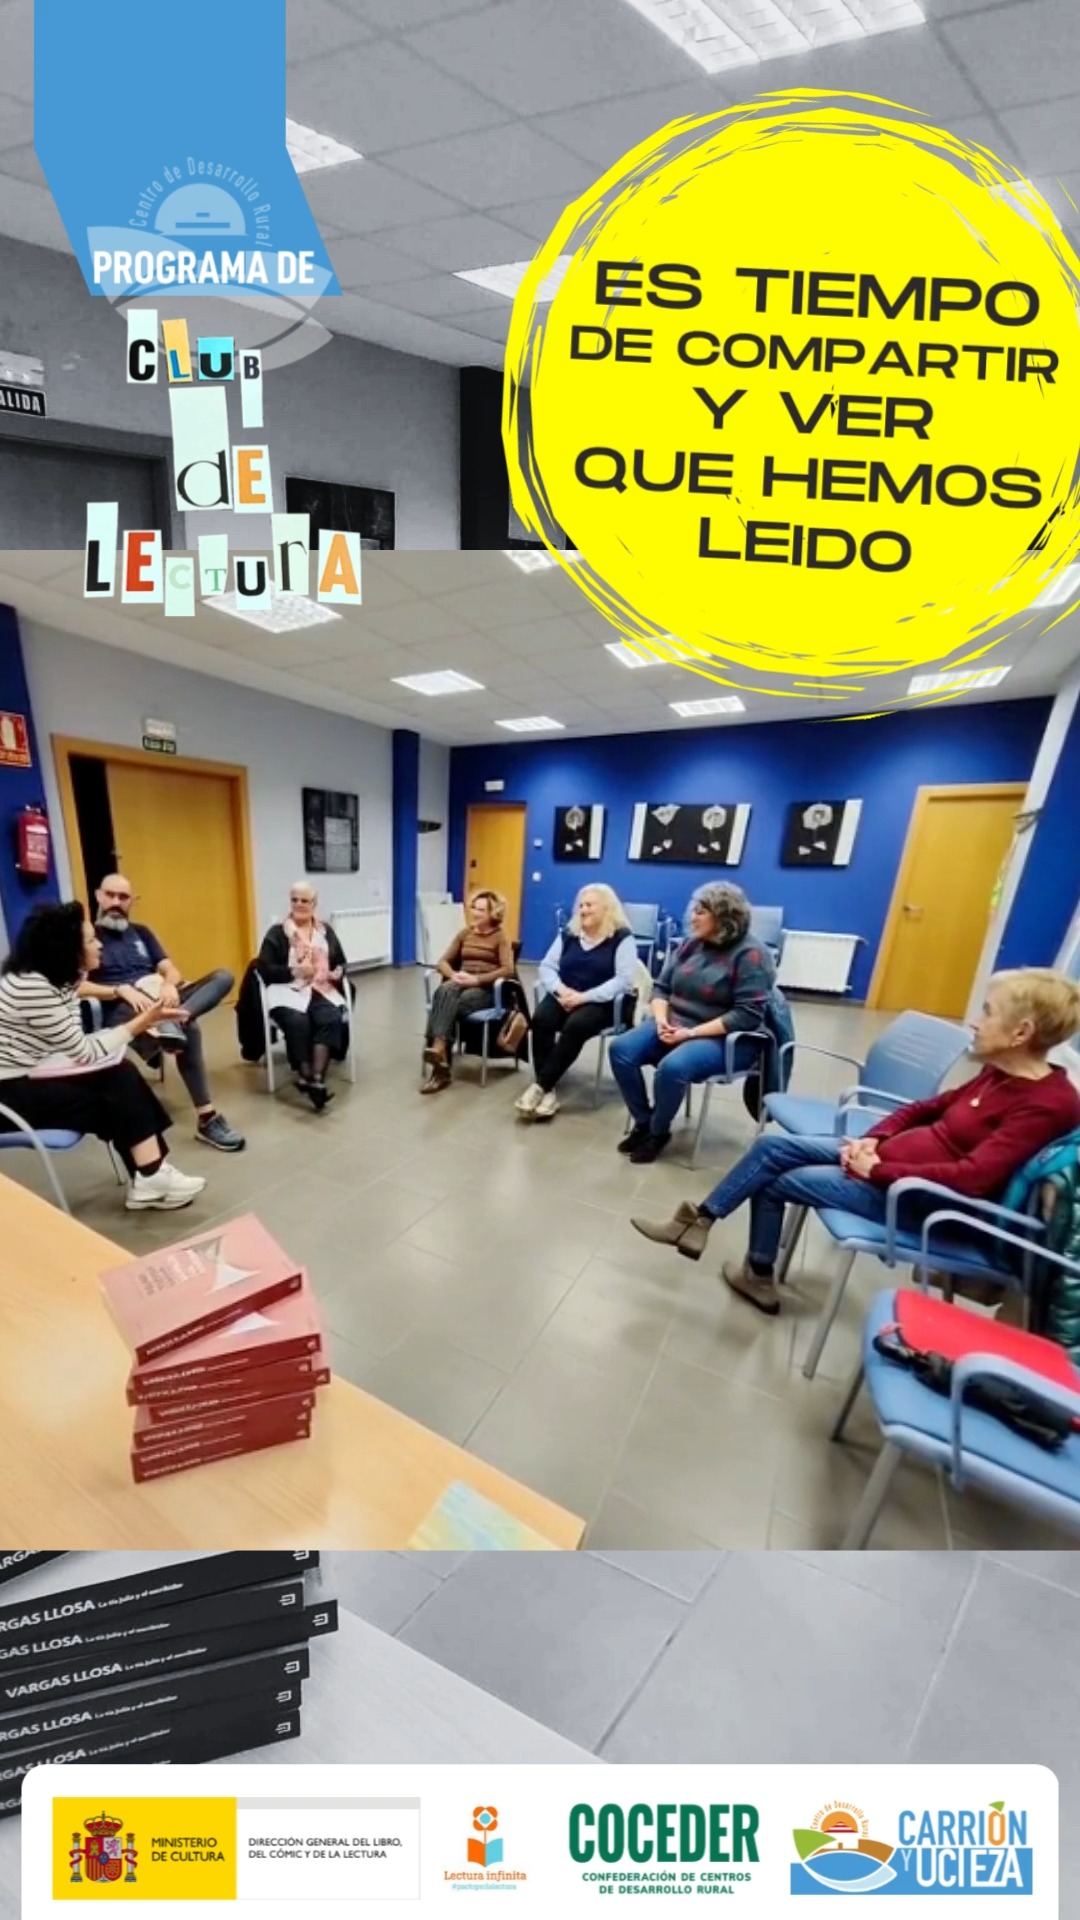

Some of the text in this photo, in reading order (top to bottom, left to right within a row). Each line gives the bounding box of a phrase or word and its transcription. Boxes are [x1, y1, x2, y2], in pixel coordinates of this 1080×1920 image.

[44, 1599, 95, 1622] LLOSA
[32, 1635, 83, 1653] LLOSA
[5, 1674, 71, 1698] VARGAS
[73, 1663, 122, 1682] LLOSA
[43, 1711, 93, 1731] LLOSA
